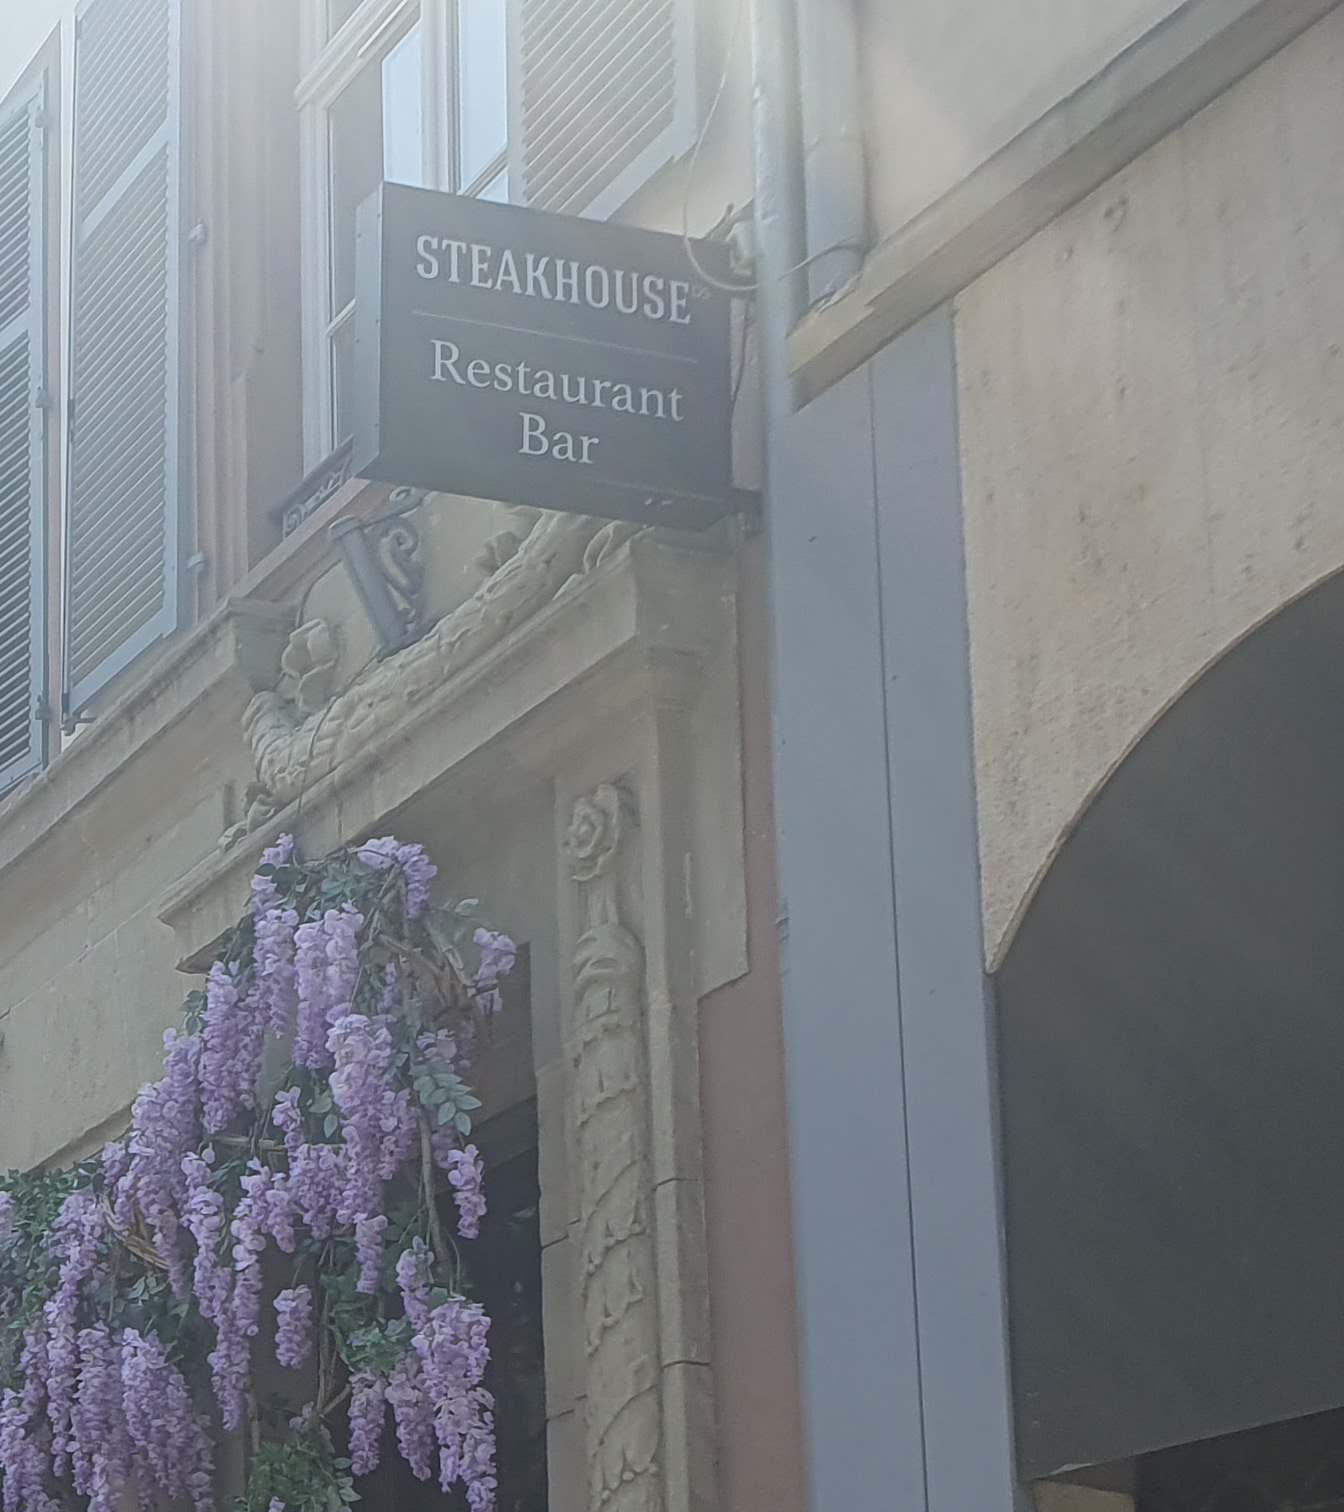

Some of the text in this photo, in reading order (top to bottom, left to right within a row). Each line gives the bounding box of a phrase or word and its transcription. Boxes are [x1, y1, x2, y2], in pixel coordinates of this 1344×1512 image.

[415, 234, 692, 326] STEAKHOUSE
[430, 339, 684, 422] Restaurant
[518, 411, 600, 465] Bar
